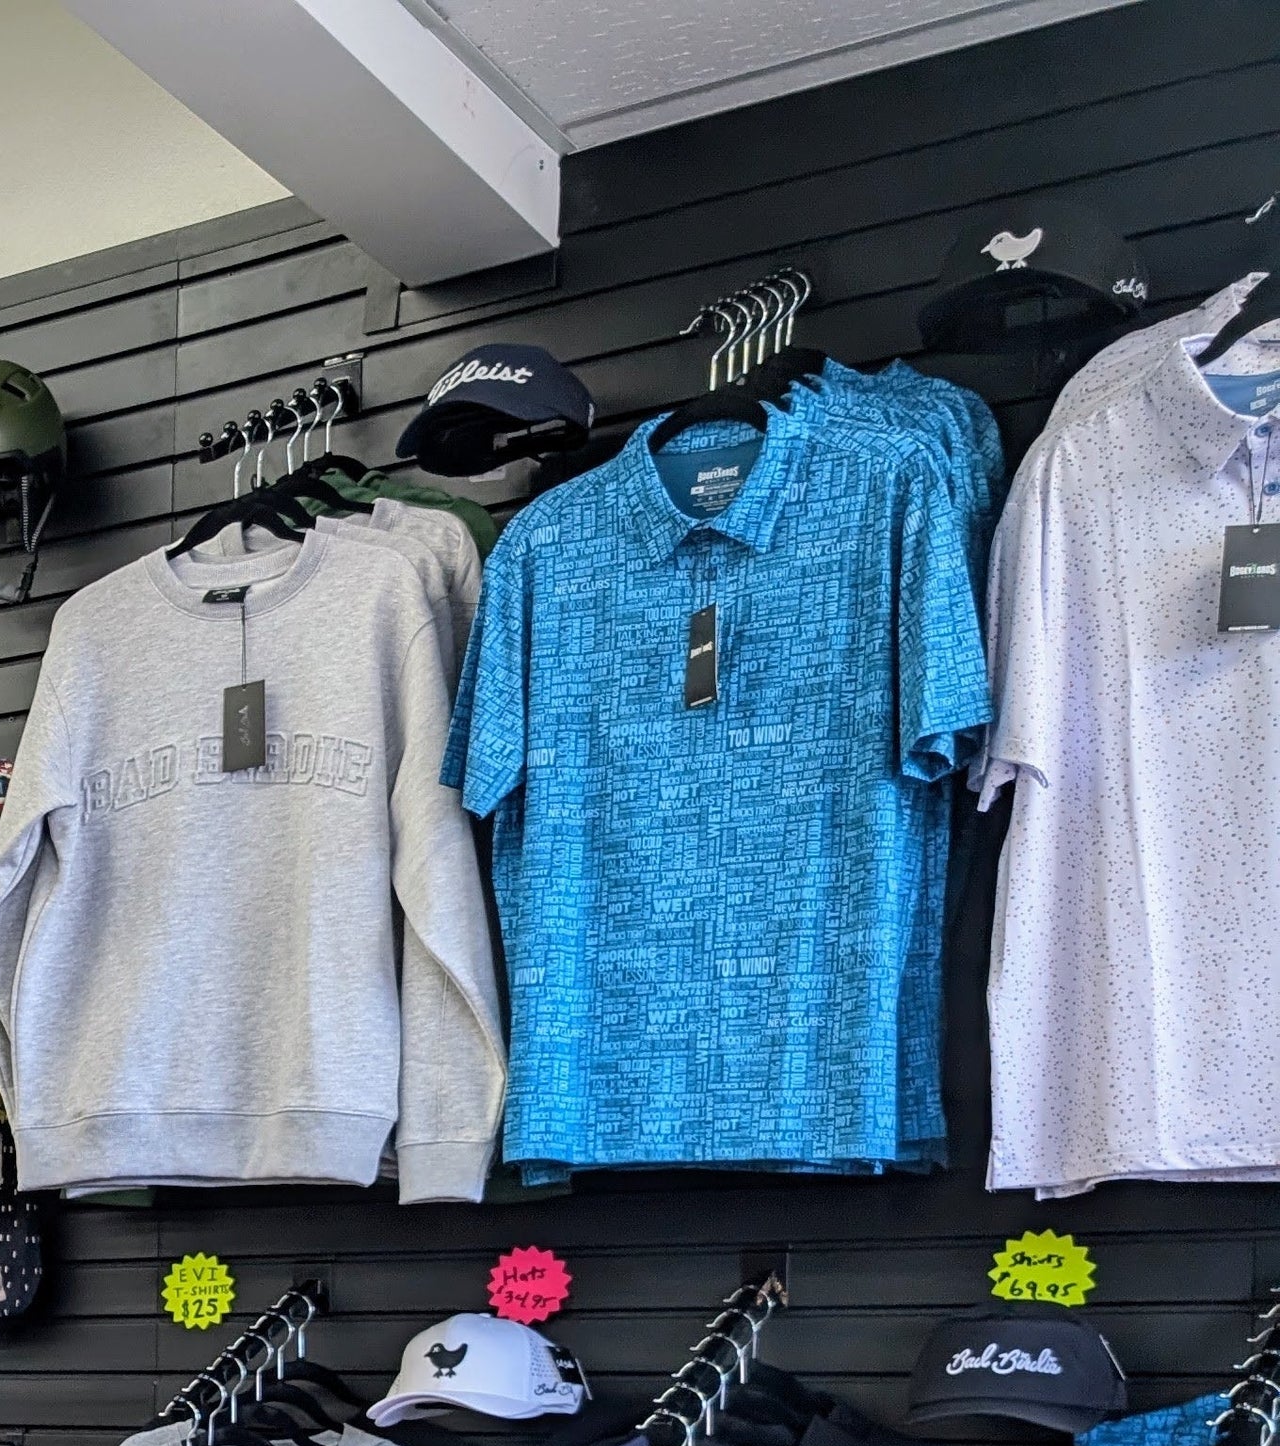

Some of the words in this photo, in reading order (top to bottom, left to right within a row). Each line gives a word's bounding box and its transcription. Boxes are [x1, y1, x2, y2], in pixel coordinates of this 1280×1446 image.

[427, 360, 532, 406] Titleist
[691, 436, 717, 448] HOT
[627, 560, 651, 572] HOT
[554, 583, 578, 594] NEW
[582, 579, 610, 591] CLUBS
[609, 721, 672, 738] WORKING
[728, 729, 750, 748] TOO
[753, 723, 793, 745] WINDY
[81, 743, 180, 826] BAD
[194, 732, 372, 797] BRDIE
[732, 778, 759, 790] HOT
[661, 784, 700, 799] WET
[503, 1266, 546, 1284] Hats
[174, 1284, 230, 1298] T-SHIRTS
[182, 1299, 218, 1319] $25
[946, 1343, 997, 1375] Bad
[991, 1348, 1063, 1374] Birdie
